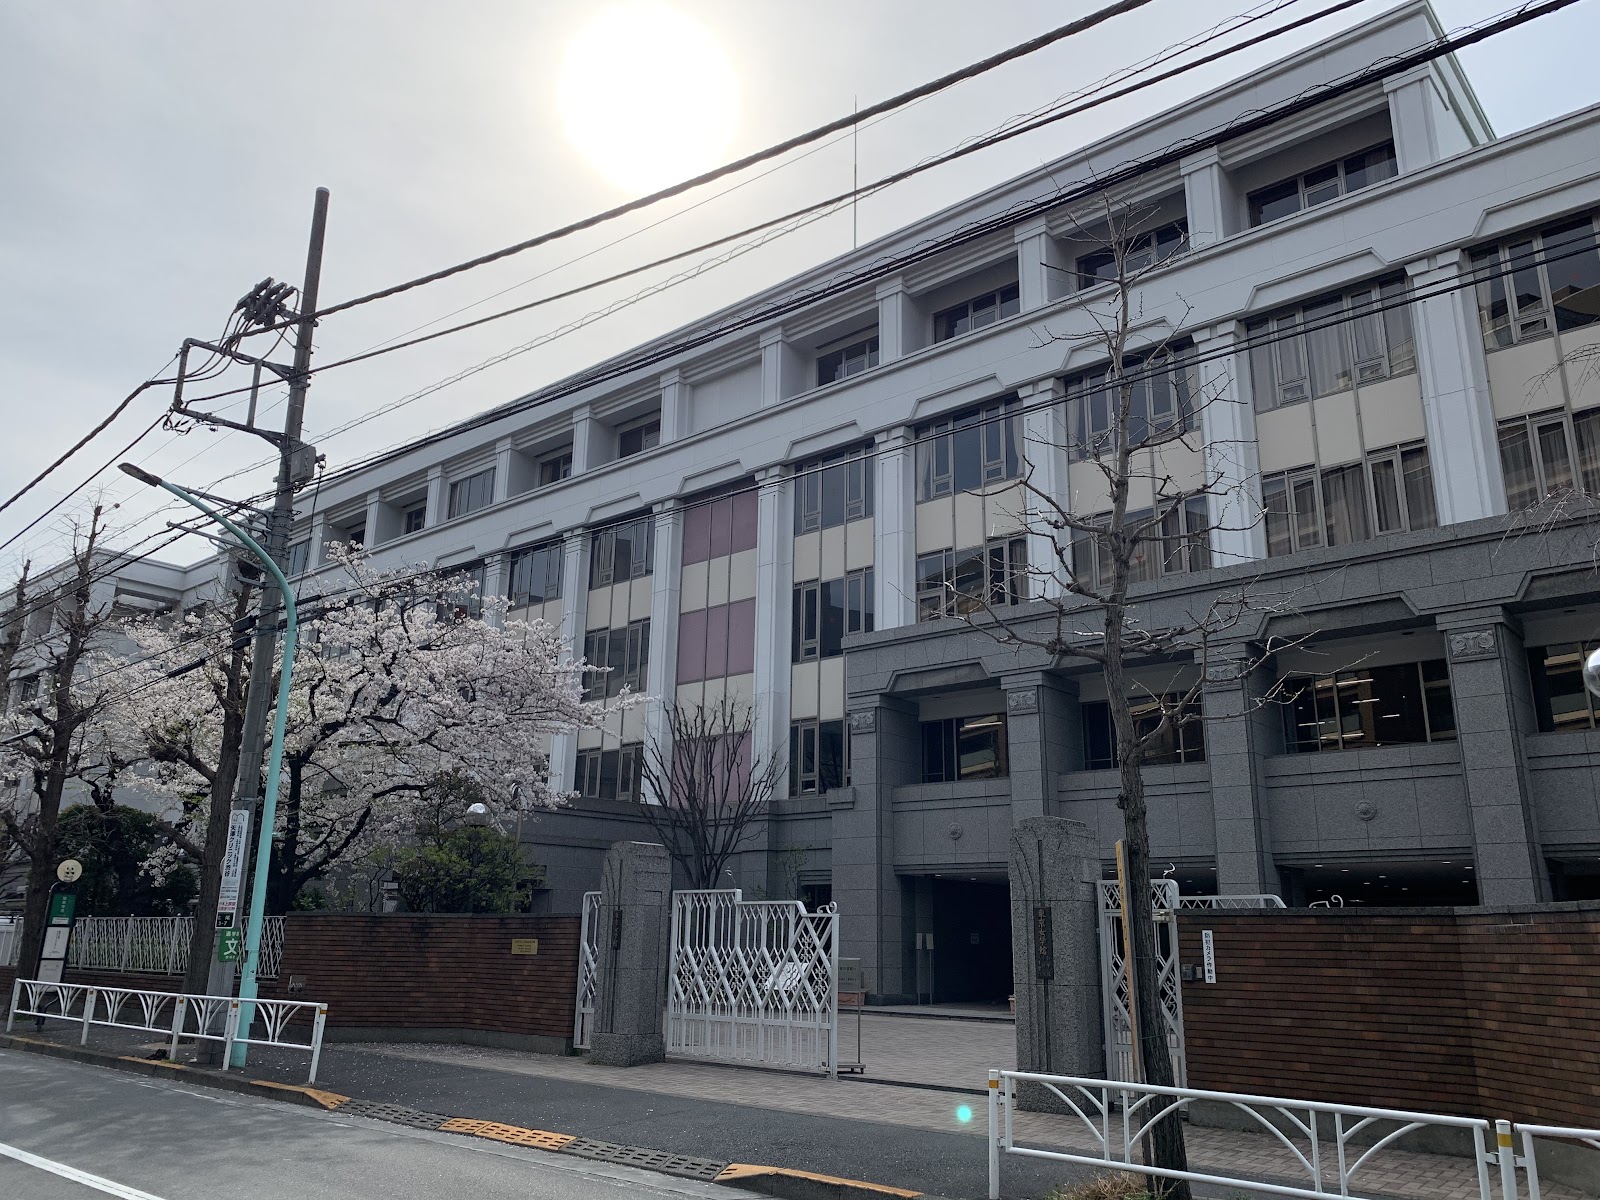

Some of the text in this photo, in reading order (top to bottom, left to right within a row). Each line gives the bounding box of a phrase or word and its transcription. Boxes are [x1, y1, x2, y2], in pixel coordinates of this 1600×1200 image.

[223, 938, 238, 955] 文
[1204, 932, 1213, 981] 防犯カメラ作動中
